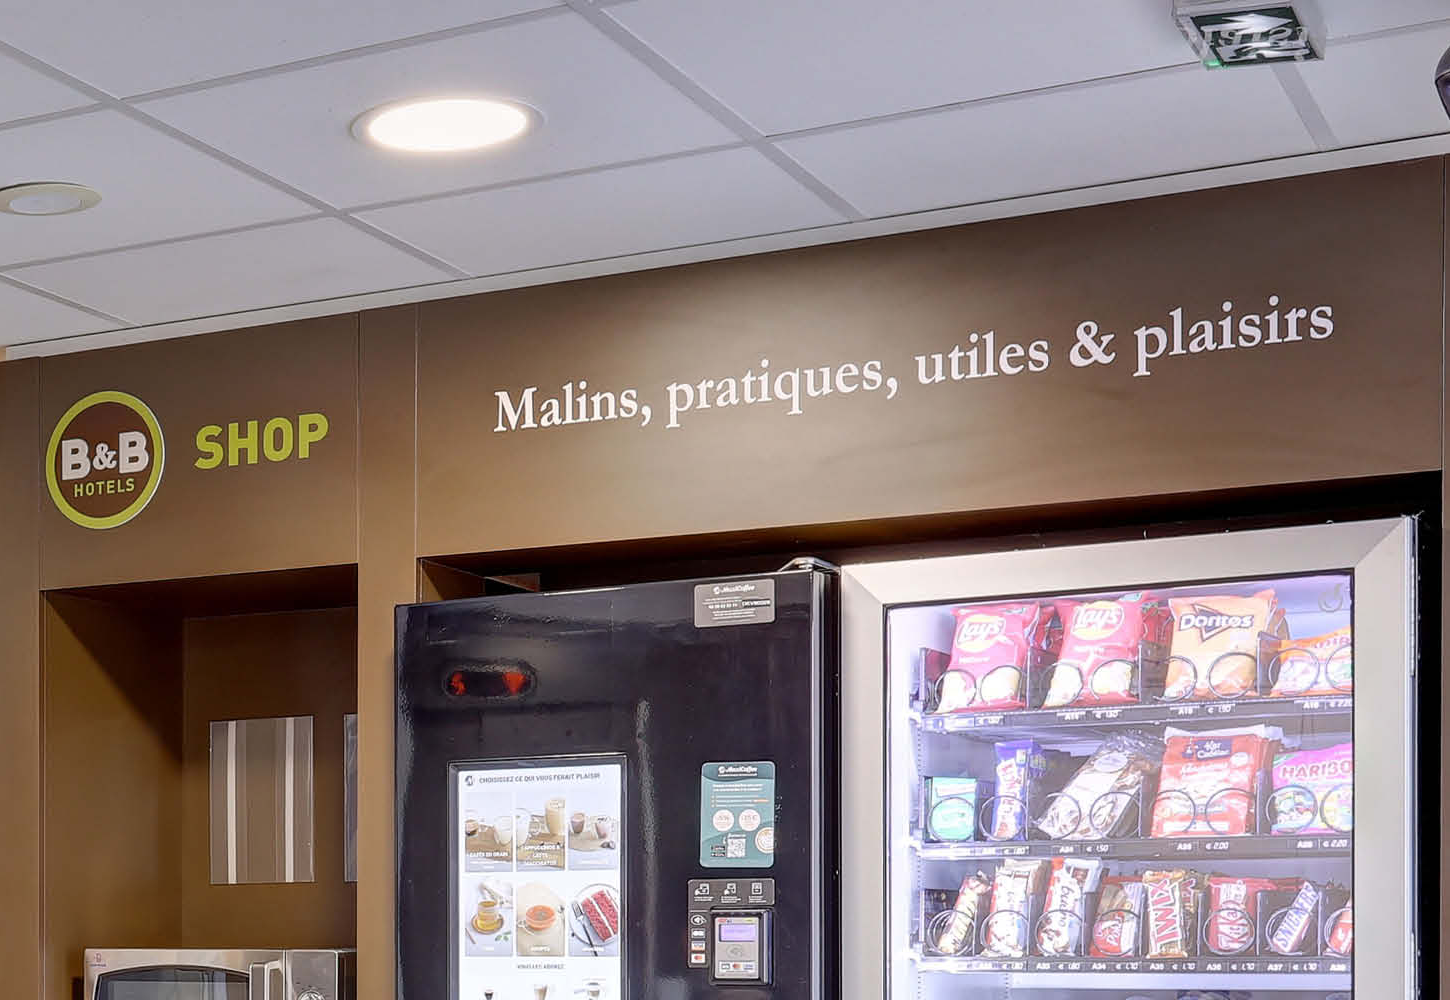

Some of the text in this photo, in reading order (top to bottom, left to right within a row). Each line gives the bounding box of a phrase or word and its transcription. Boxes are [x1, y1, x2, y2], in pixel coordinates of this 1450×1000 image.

[493, 295, 1335, 432] Malins, pratiques, utiles & plaisirs
[61, 430, 149, 480] B&B
[194, 412, 329, 470] SHOP
[73, 477, 136, 498] HOTELS
[1178, 615, 1255, 631] Doritos
